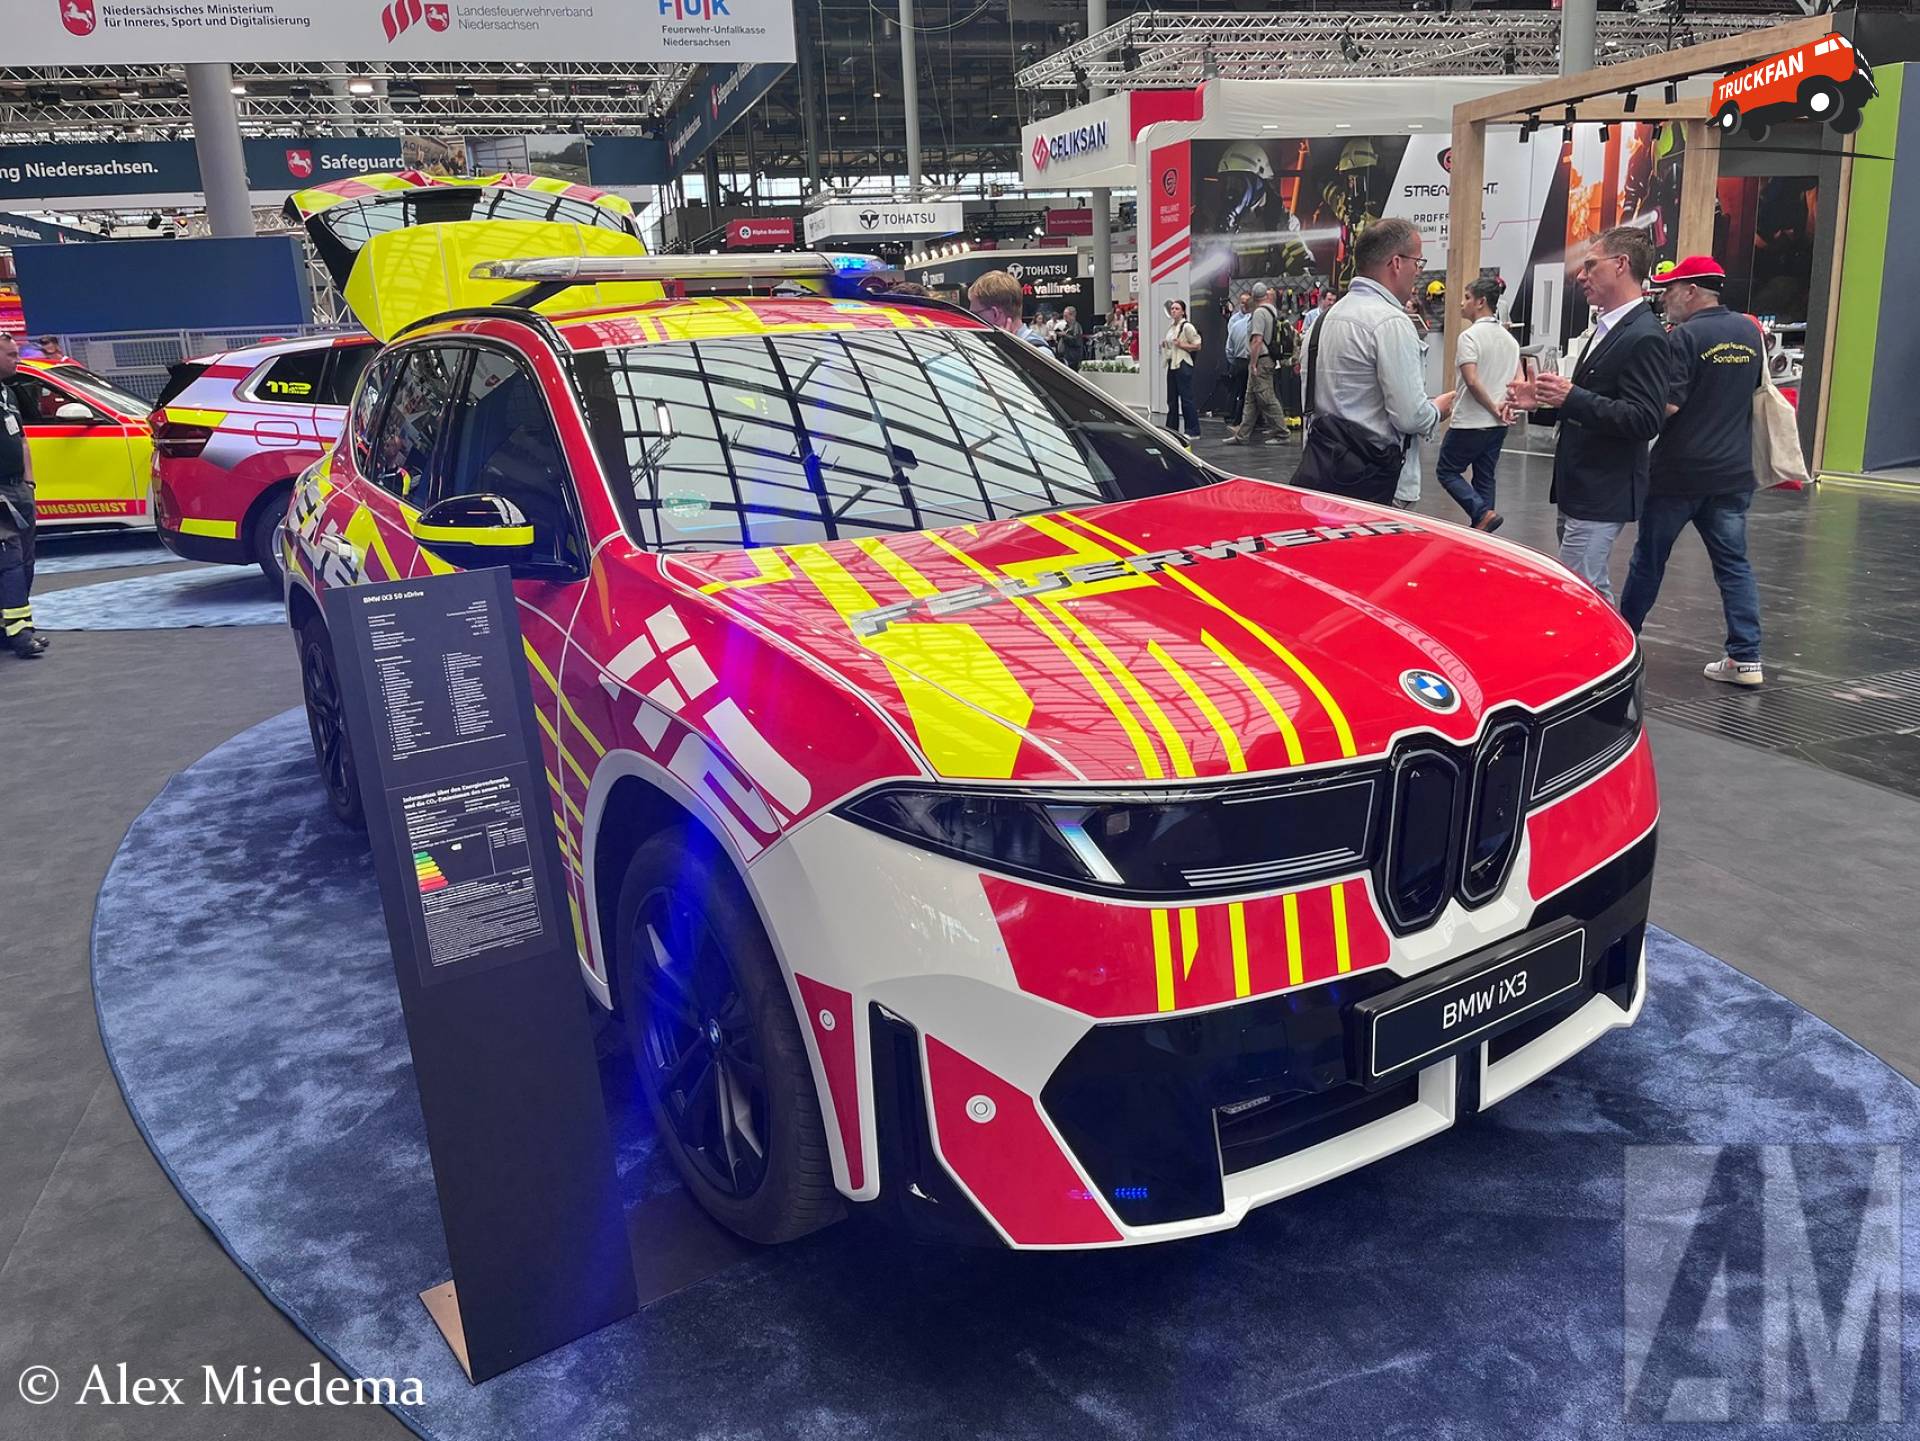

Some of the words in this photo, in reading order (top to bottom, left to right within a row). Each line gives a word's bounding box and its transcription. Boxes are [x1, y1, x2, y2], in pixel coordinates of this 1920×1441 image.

[103, 5, 204, 16] Niedersächsisches
[207, 4, 274, 15] Ministerium
[456, 5, 594, 18] Landesfeuerwehrverband
[104, 17, 121, 28] für
[124, 17, 169, 28] Inneres,
[172, 16, 202, 28] Sport
[206, 16, 227, 26] und
[230, 15, 311, 28] Digitalisierung
[458, 19, 540, 31] Niedersachsen
[662, 25, 766, 35] Feuerwehr-Unfallkasse
[663, 37, 731, 46] Niedersachsen
[1050, 121, 1108, 160] CELIKSAN
[320, 154, 405, 172] Safeguard
[0, 164, 20, 182] ng
[25, 159, 159, 178] Niedersachsen.
[883, 212, 936, 225] TOHATSU
[1025, 264, 1068, 276] TOHATSU
[37, 501, 127, 515] UNGSDIENST
[849, 520, 1426, 638] FEUERWEHR
[1442, 984, 1495, 1030] BMW
[1498, 970, 1528, 1004] iX3
